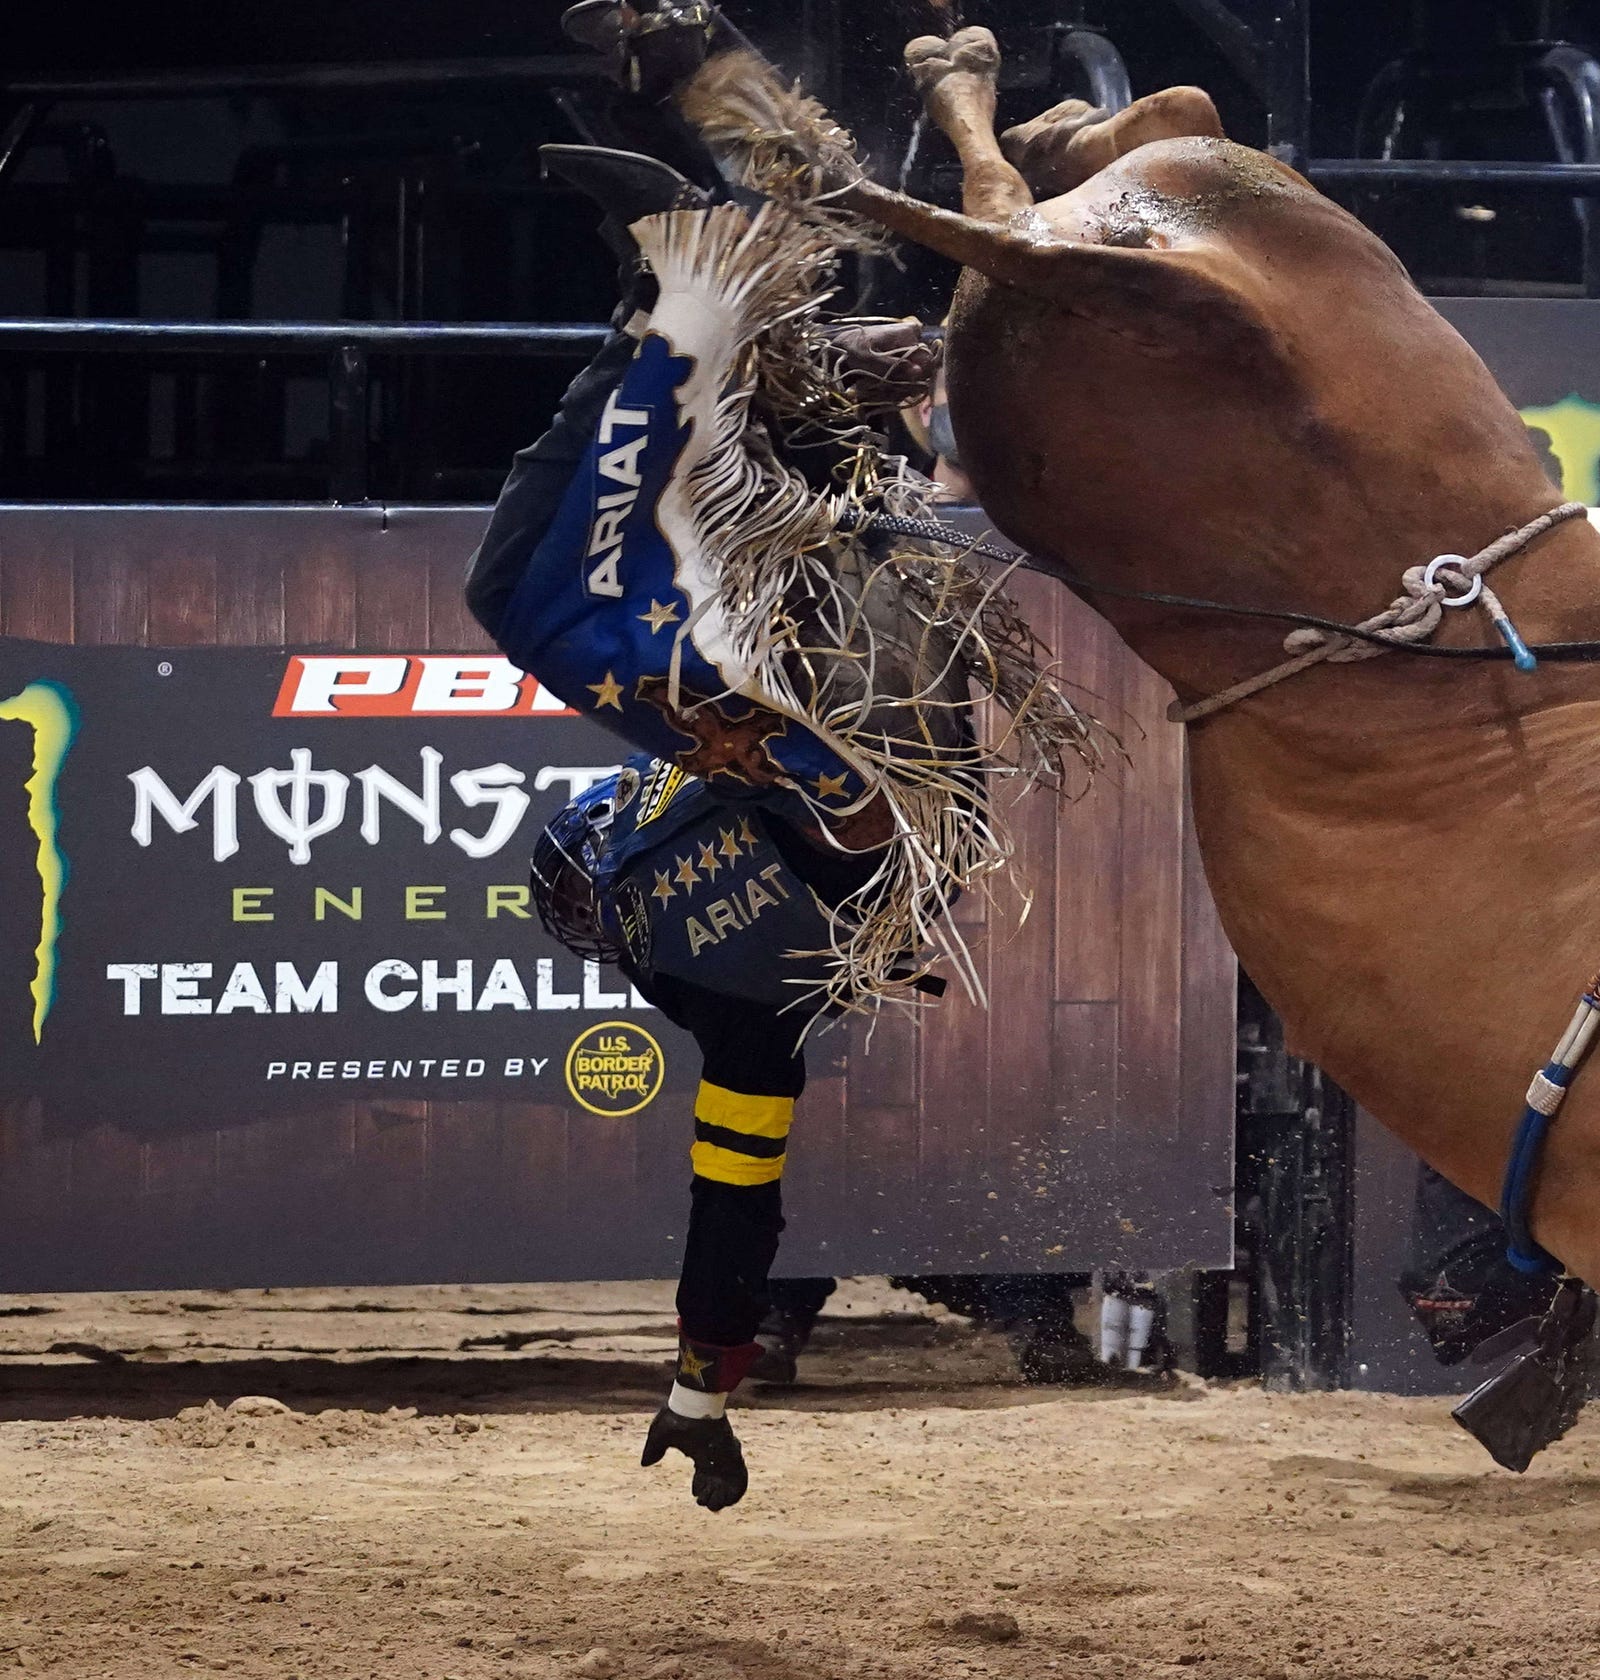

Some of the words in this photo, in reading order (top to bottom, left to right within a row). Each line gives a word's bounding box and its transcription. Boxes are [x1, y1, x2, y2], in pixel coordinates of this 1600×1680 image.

[587, 388, 649, 598] ARIAT
[685, 863, 790, 958] ARIAT
[107, 961, 339, 1015] TEAM
[598, 1036, 631, 1052] U.S.
[267, 1059, 485, 1080] PRESENTED
[504, 1058, 549, 1077] BY
[578, 1056, 652, 1072] BORDER
[579, 1073, 649, 1090] PATROL
